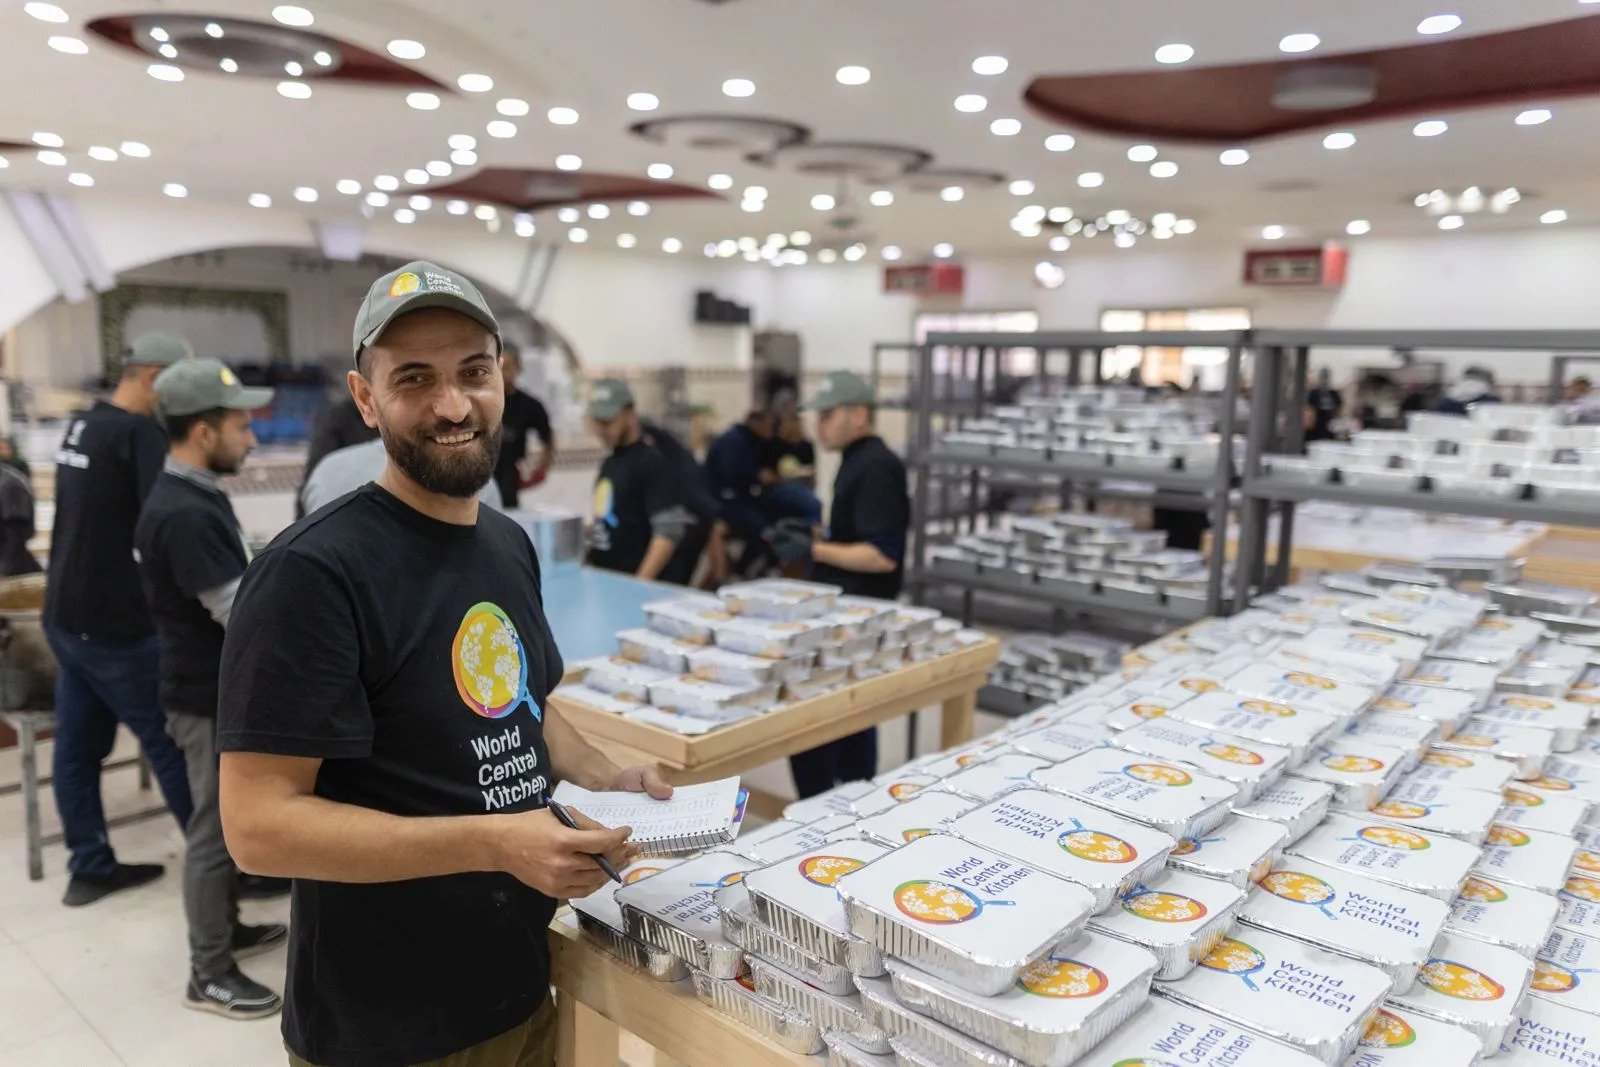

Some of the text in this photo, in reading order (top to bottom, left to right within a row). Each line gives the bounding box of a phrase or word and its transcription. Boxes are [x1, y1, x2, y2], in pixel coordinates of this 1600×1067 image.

[470, 725, 521, 761] World
[478, 746, 537, 786] Central
[481, 775, 547, 811] Kitchen
[991, 808, 1055, 832] Central
[994, 817, 1046, 839] World
[999, 802, 1064, 827] Kitchen
[938, 856, 984, 879] World
[961, 859, 1012, 887] Central
[980, 867, 1034, 896] Kitchen
[656, 890, 713, 915] Kitchen
[674, 900, 716, 922] entral
[699, 908, 720, 924] rld
[1345, 899, 1420, 928] Central
[1348, 891, 1407, 914] World
[1339, 906, 1419, 938] Kitchen
[1272, 969, 1356, 1003] Central
[1280, 960, 1344, 988] World
[1264, 976, 1352, 1013] Kitchen
[1150, 1021, 1196, 1054] World
[1178, 1024, 1229, 1064] Central
[1519, 1017, 1587, 1045] World
[1511, 1036, 1595, 1067] Kitche
